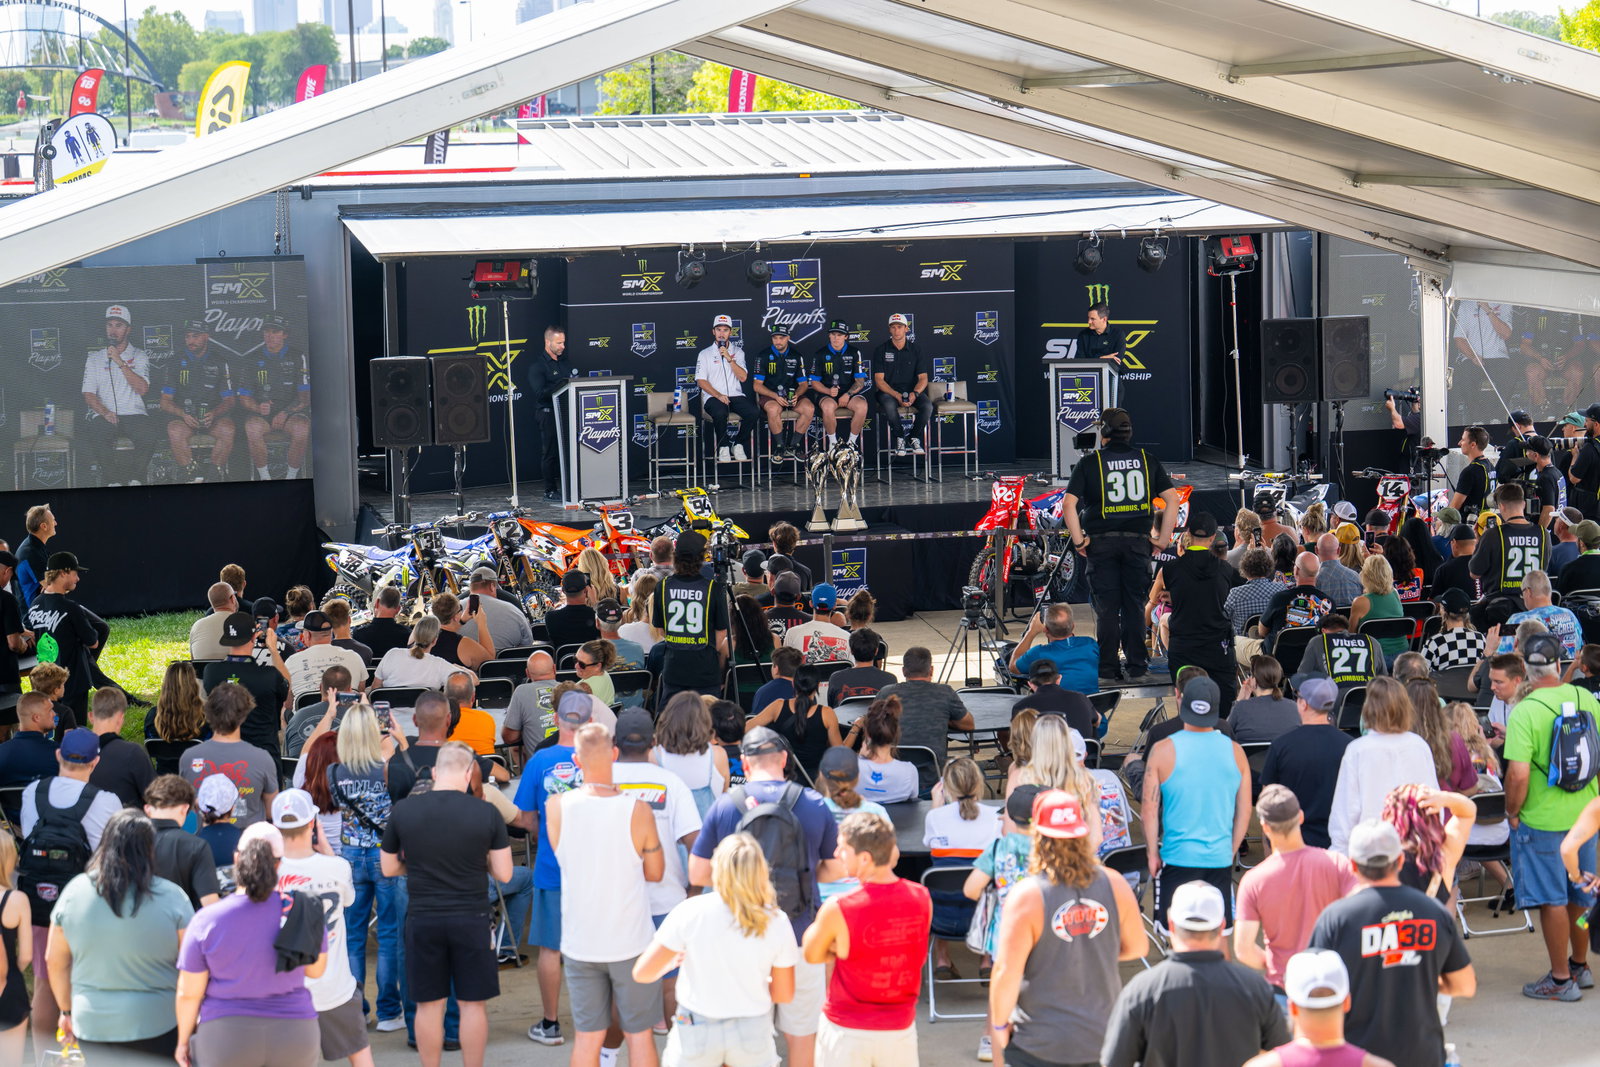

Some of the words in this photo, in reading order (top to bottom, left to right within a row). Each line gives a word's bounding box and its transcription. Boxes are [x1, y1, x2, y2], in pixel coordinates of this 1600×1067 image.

[16, 268, 69, 287] MX
[920, 264, 964, 281] SMX
[210, 277, 266, 298] SMX
[621, 276, 663, 291] SMX
[771, 282, 816, 299] SMX
[205, 309, 264, 340] Playo
[761, 306, 827, 332] Playoffs
[1063, 390, 1092, 402] SMX
[584, 409, 613, 421] SMX
[1056, 406, 1100, 423] Playoffs
[579, 426, 621, 443] Playoffs
[1107, 459, 1141, 471] VIDEO
[1106, 470, 1145, 503] 30
[1382, 482, 1405, 497] 14
[1104, 504, 1139, 513] COLUMBUS,
[504, 520, 520, 538] 2
[613, 514, 631, 530] 3
[1509, 536, 1539, 547] VIDEO
[1506, 547, 1540, 578] 25
[669, 588, 703, 600] VIDEO
[667, 600, 704, 634] 29
[229, 624, 237, 637] LA
[1332, 639, 1365, 647] VIDEO
[1331, 647, 1369, 674] 27
[1333, 675, 1367, 683] OLUMBUS,
[1361, 922, 1434, 955] DA38
